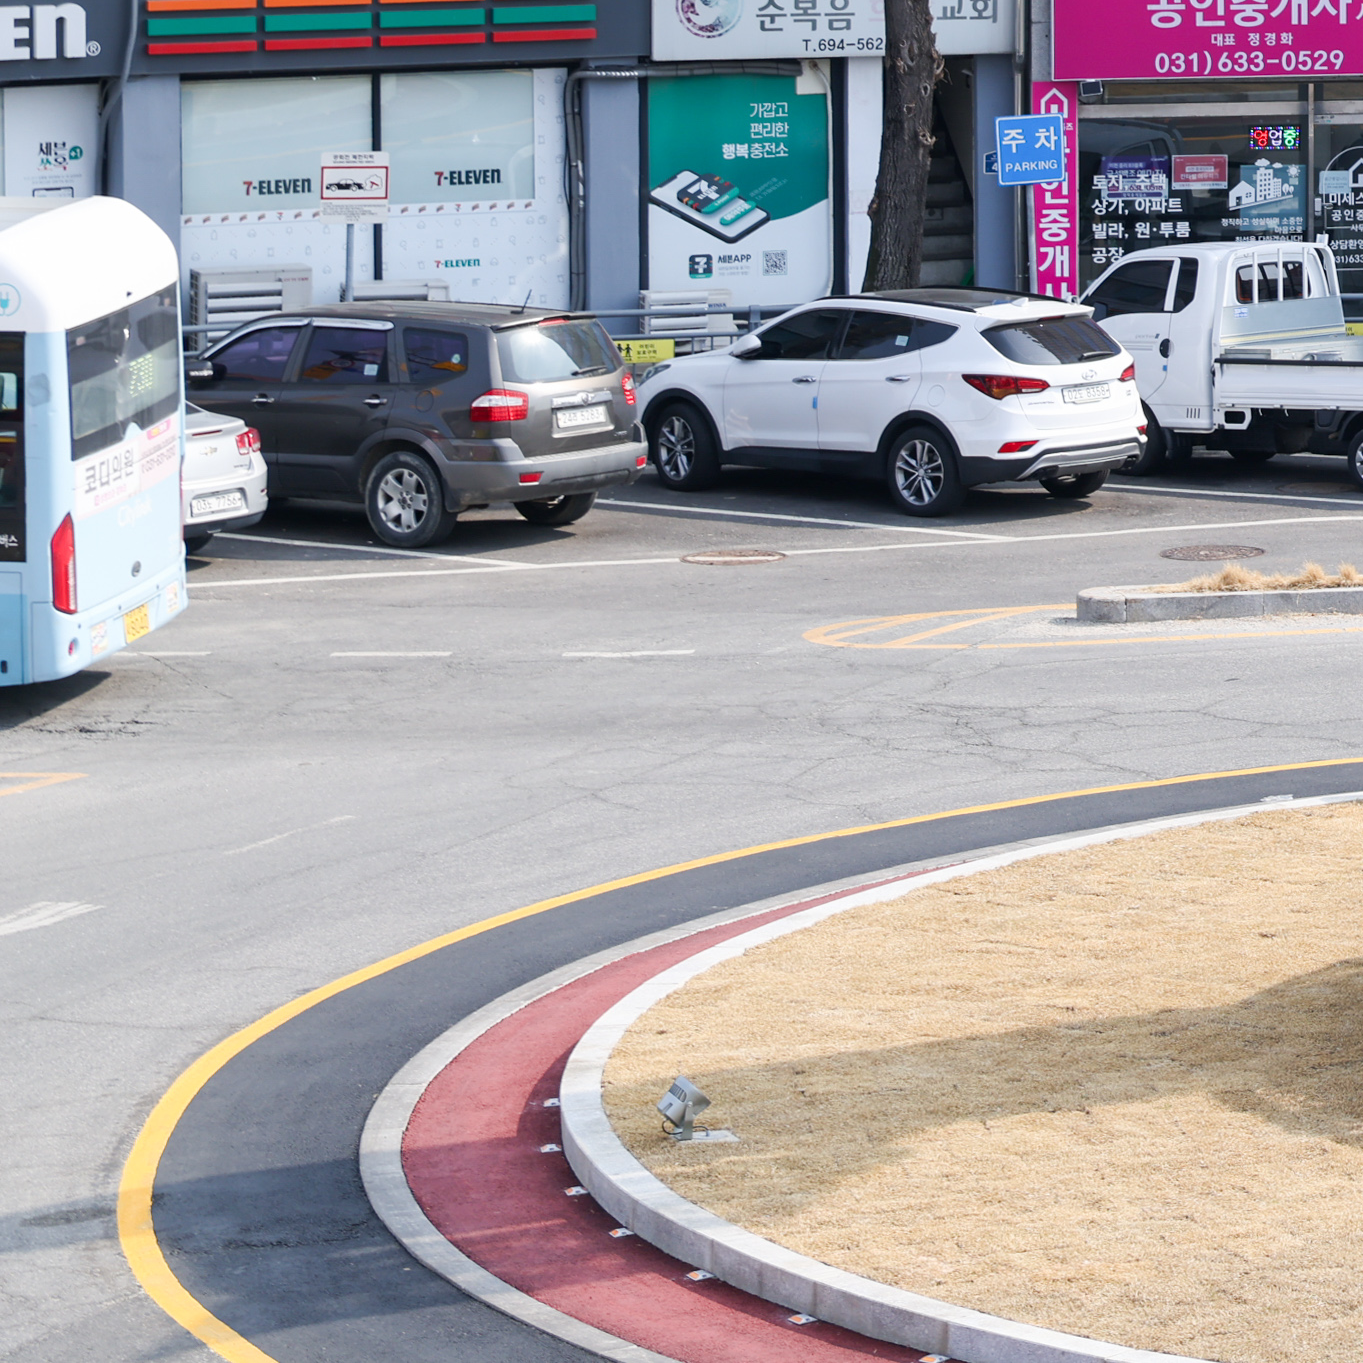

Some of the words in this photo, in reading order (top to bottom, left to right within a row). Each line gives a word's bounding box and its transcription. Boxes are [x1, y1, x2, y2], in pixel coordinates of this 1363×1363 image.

[802, 38, 884, 53] T.694-562
[1211, 32, 1236, 46] 대표
[1248, 31, 1294, 46] 정경화
[1154, 49, 1345, 74] 031)633-0529
[749, 101, 789, 119] 가깝고
[749, 122, 789, 139] 편리한
[1253, 129, 1297, 147] 영업중
[1002, 125, 1058, 154] 주차
[1005, 159, 1058, 173] PARKING
[1135, 173, 1167, 190] 주택
[1135, 198, 1183, 214] 아파트
[1221, 218, 1250, 227] 정직하고
[1281, 217, 1303, 226] 소중한
[1092, 247, 1125, 264] 공장
